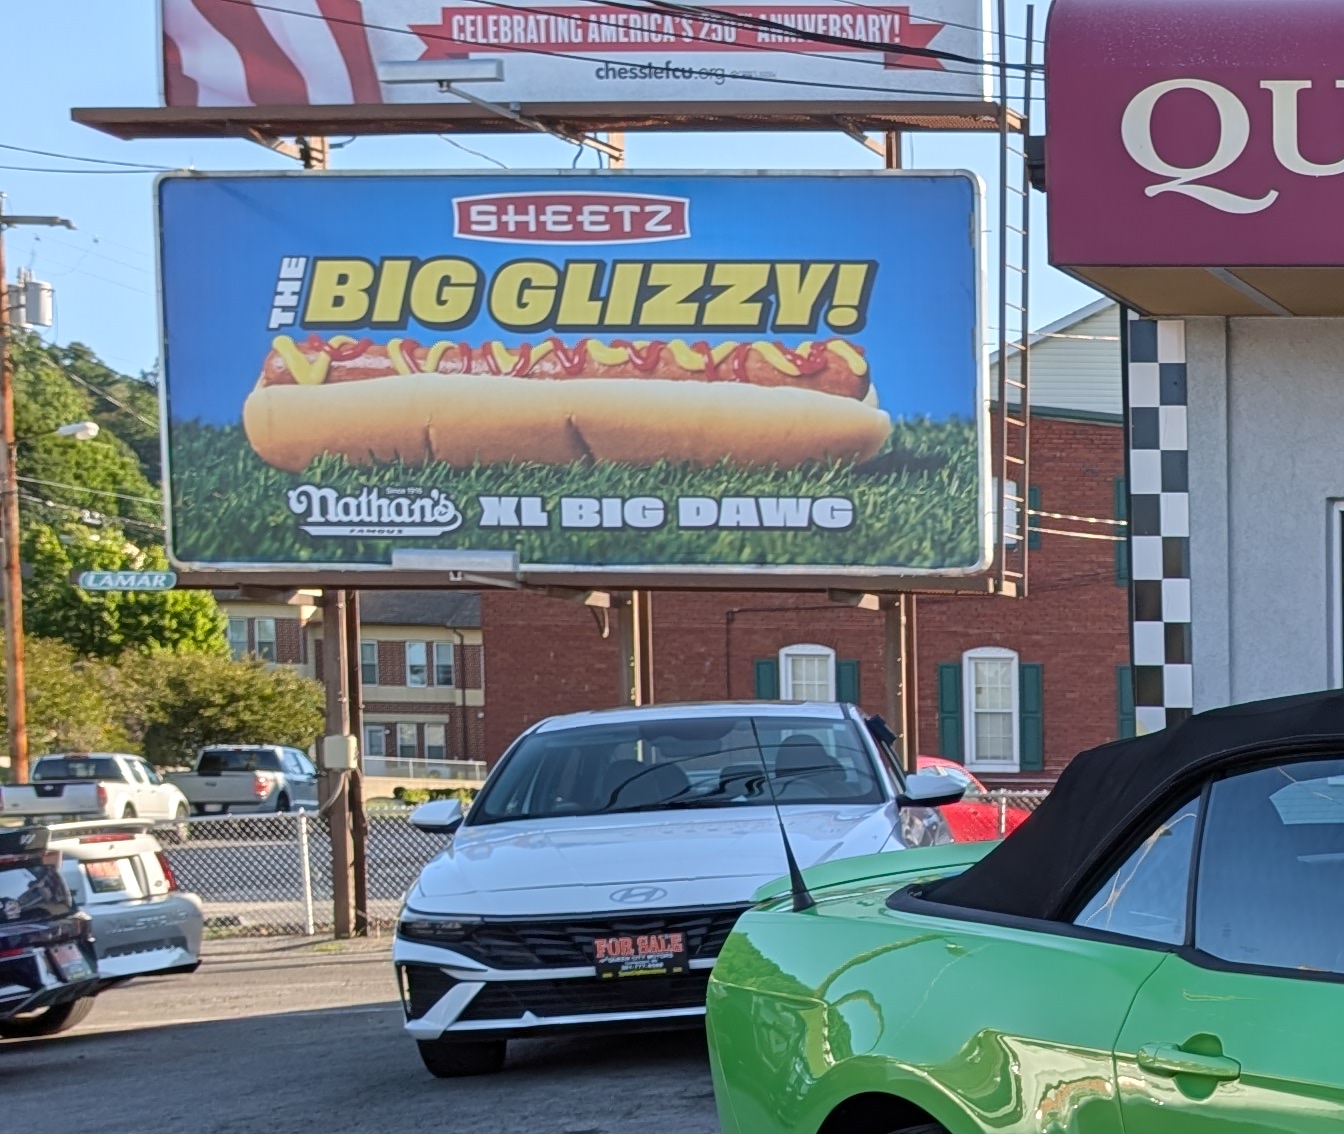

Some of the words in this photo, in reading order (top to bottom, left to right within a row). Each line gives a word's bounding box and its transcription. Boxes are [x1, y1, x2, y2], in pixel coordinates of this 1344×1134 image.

[451, 14, 583, 45] CELEBRATING
[587, 14, 694, 44] AMERICA'S
[757, 13, 900, 44] ANNIVERSARY!
[470, 203, 673, 234] SHEETZ
[268, 256, 307, 329] THE
[303, 258, 478, 325] BIG
[490, 261, 870, 328] GLIZZY!
[287, 484, 462, 524] Nathan's
[478, 496, 549, 528] XL
[562, 497, 665, 528] BIG
[678, 498, 855, 529] DAWG
[87, 575, 167, 587] LAMAR
[594, 937, 635, 958] FOR
[637, 933, 683, 952] SALE
